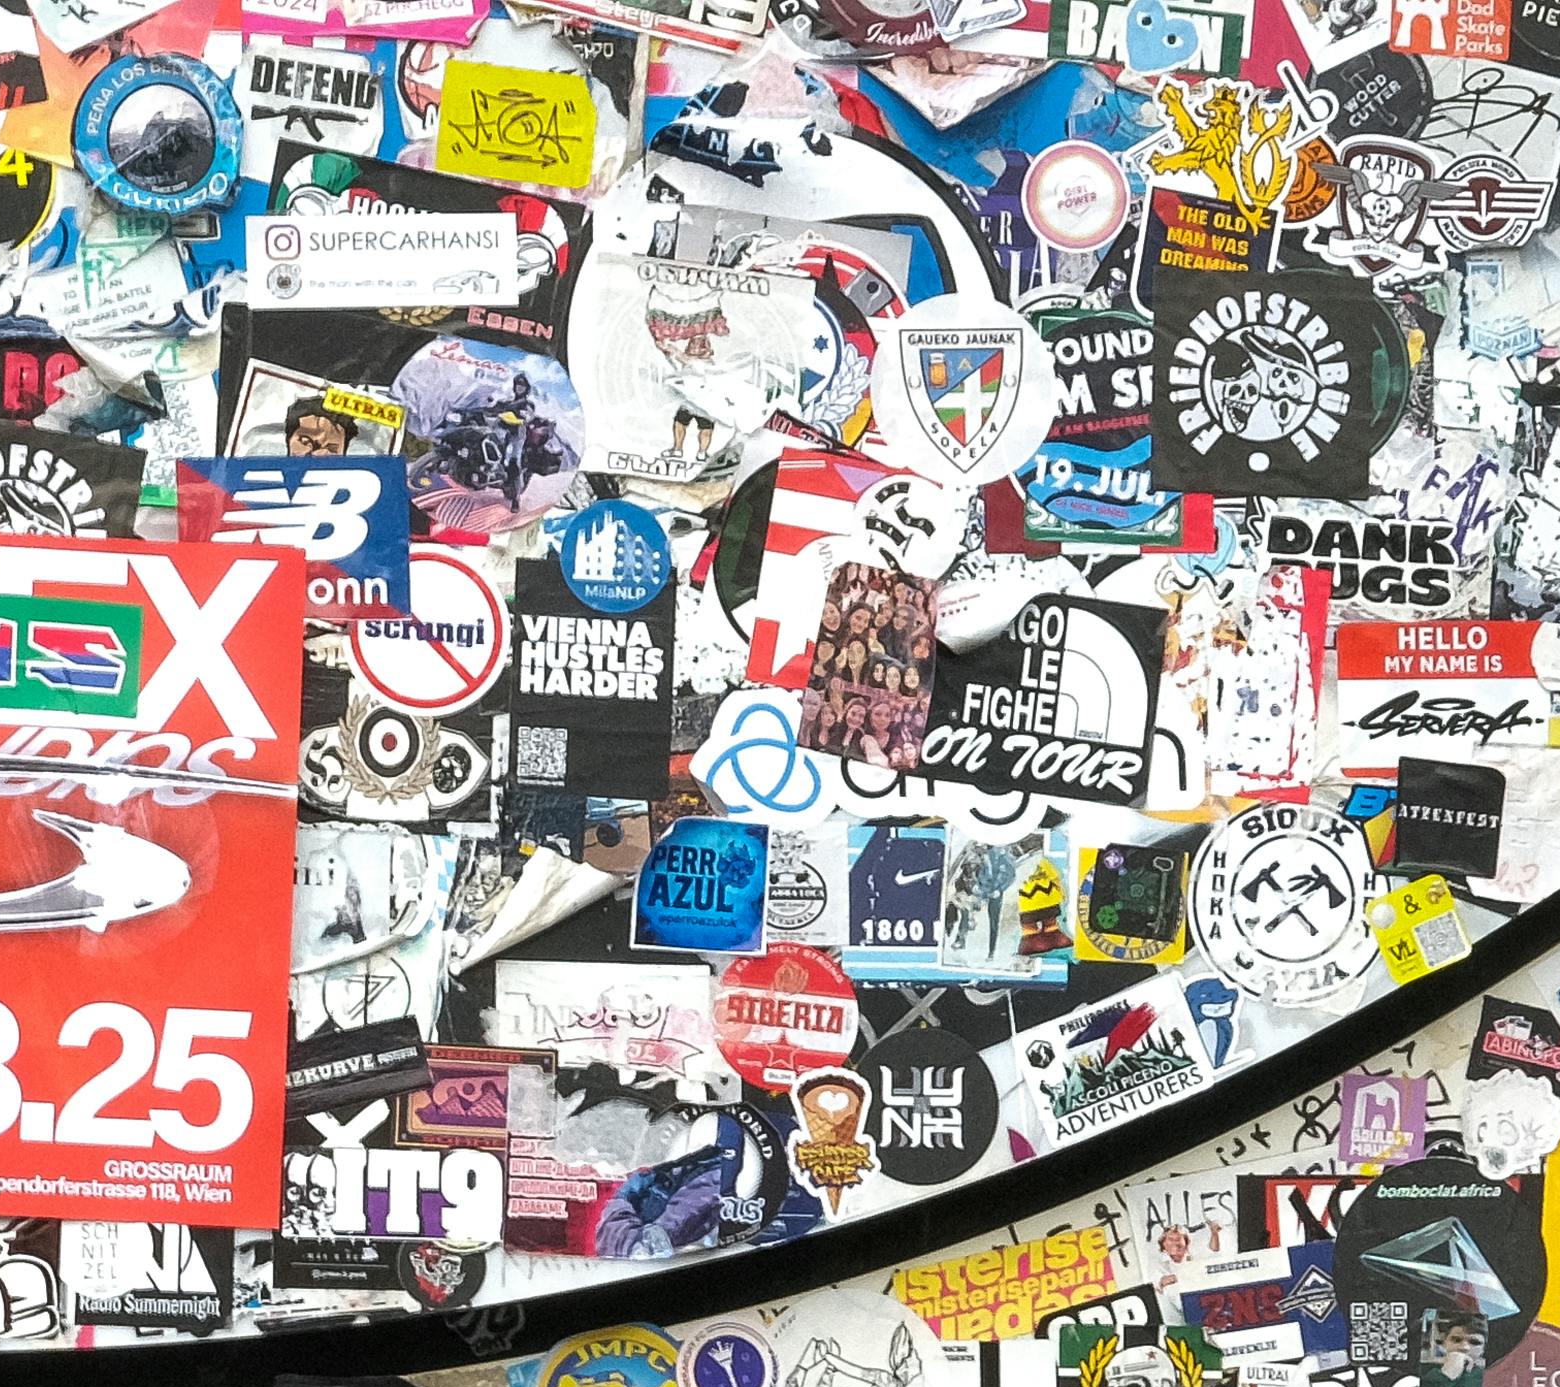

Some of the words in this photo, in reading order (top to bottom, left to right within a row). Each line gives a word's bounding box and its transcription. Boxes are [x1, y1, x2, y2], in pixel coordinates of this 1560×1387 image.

[1456, 18, 1506, 37] Skate
[1454, 35, 1504, 56] Parks
[251, 56, 375, 109] DEFEND
[1361, 155, 1416, 180] RAPID
[1213, 211, 1247, 233] OLD
[309, 232, 500, 253] SUPERCARHANSI
[1167, 229, 1206, 247] MAN
[1211, 236, 1249, 256] WAS
[907, 332, 960, 346] GAUEKO
[965, 330, 1016, 346] JAUNAK
[329, 390, 403, 425] ULTRAS
[1267, 519, 1456, 560] DANK
[584, 585, 647, 602] MilaNLP
[521, 617, 653, 648] VIENNA
[1397, 626, 1489, 654] HELLO
[522, 643, 664, 674] HUSTLES
[1021, 650, 1060, 688] LE
[1385, 657, 1412, 673] MY
[1416, 657, 1478, 673] NAME
[1482, 657, 1504, 673] IS
[521, 670, 657, 701] HARDER
[962, 684, 1056, 731] FIGHE
[1001, 736, 1143, 797] TOUR
[1241, 806, 1352, 845] SIOUX
[648, 876, 734, 914] AZUL
[861, 919, 925, 943] 1860
[726, 999, 844, 1035] SIBERIA
[1058, 1067, 1205, 1142] ADVENTURERS
[102, 1160, 234, 1183] GROSSRAUM
[182, 1184, 232, 1203] Wien
[1376, 1183, 1503, 1201] bomboclat.africa
[1145, 1186, 1235, 1234] ALLES
